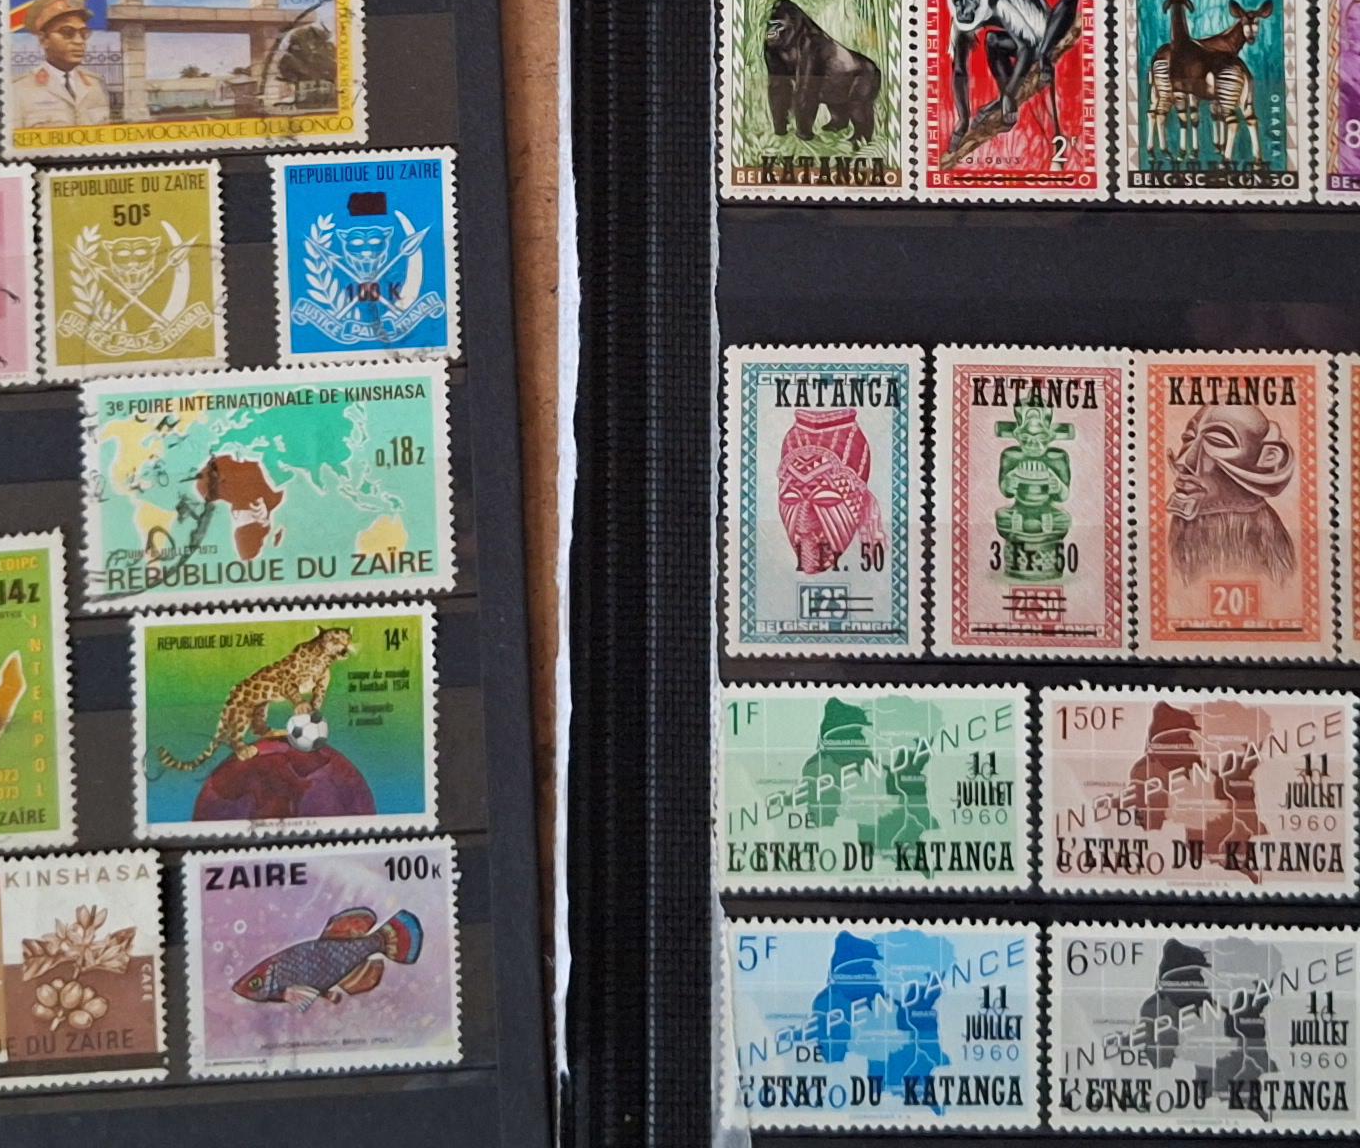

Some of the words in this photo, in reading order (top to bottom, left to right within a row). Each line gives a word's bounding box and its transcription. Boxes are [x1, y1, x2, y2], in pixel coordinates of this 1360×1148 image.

[113, 123, 248, 142] DEMOCRATIQUE
[290, 117, 353, 134] CONGO
[289, 166, 370, 184] REPUBLIQUE
[377, 164, 394, 180] DU
[761, 156, 887, 186] KATANGA
[53, 180, 134, 198] REPUBLIQUE
[142, 178, 161, 194] DU
[128, 397, 173, 414] FOIRE
[179, 392, 314, 412] INTERNATIONALE
[319, 389, 339, 404] DE
[344, 383, 425, 403] KINSHASA
[775, 377, 901, 409] KATANGA
[971, 376, 1098, 410] KATANGA
[1168, 375, 1296, 406] KATANGA
[108, 557, 284, 591] REPUBLIQUE
[298, 555, 337, 579] DU
[351, 546, 433, 577] ZAÏRE
[956, 780, 1013, 808] JUILLET
[952, 808, 1008, 825] 1960
[1280, 815, 1336, 831] 1960
[843, 839, 874, 871] DU
[895, 839, 1014, 872] KATANGA
[1172, 840, 1203, 870] DU
[1223, 839, 1344, 873] KATANGA
[5, 864, 151, 890] KINSHASA
[204, 861, 309, 892] ZAIRE
[25, 1033, 56, 1052] DU
[65, 1027, 134, 1050] ZAIRE
[961, 1044, 1019, 1062] 1960
[851, 1075, 882, 1108] DU
[904, 1074, 1023, 1107] KATANGA
[1230, 1078, 1349, 1111] KATANGA
